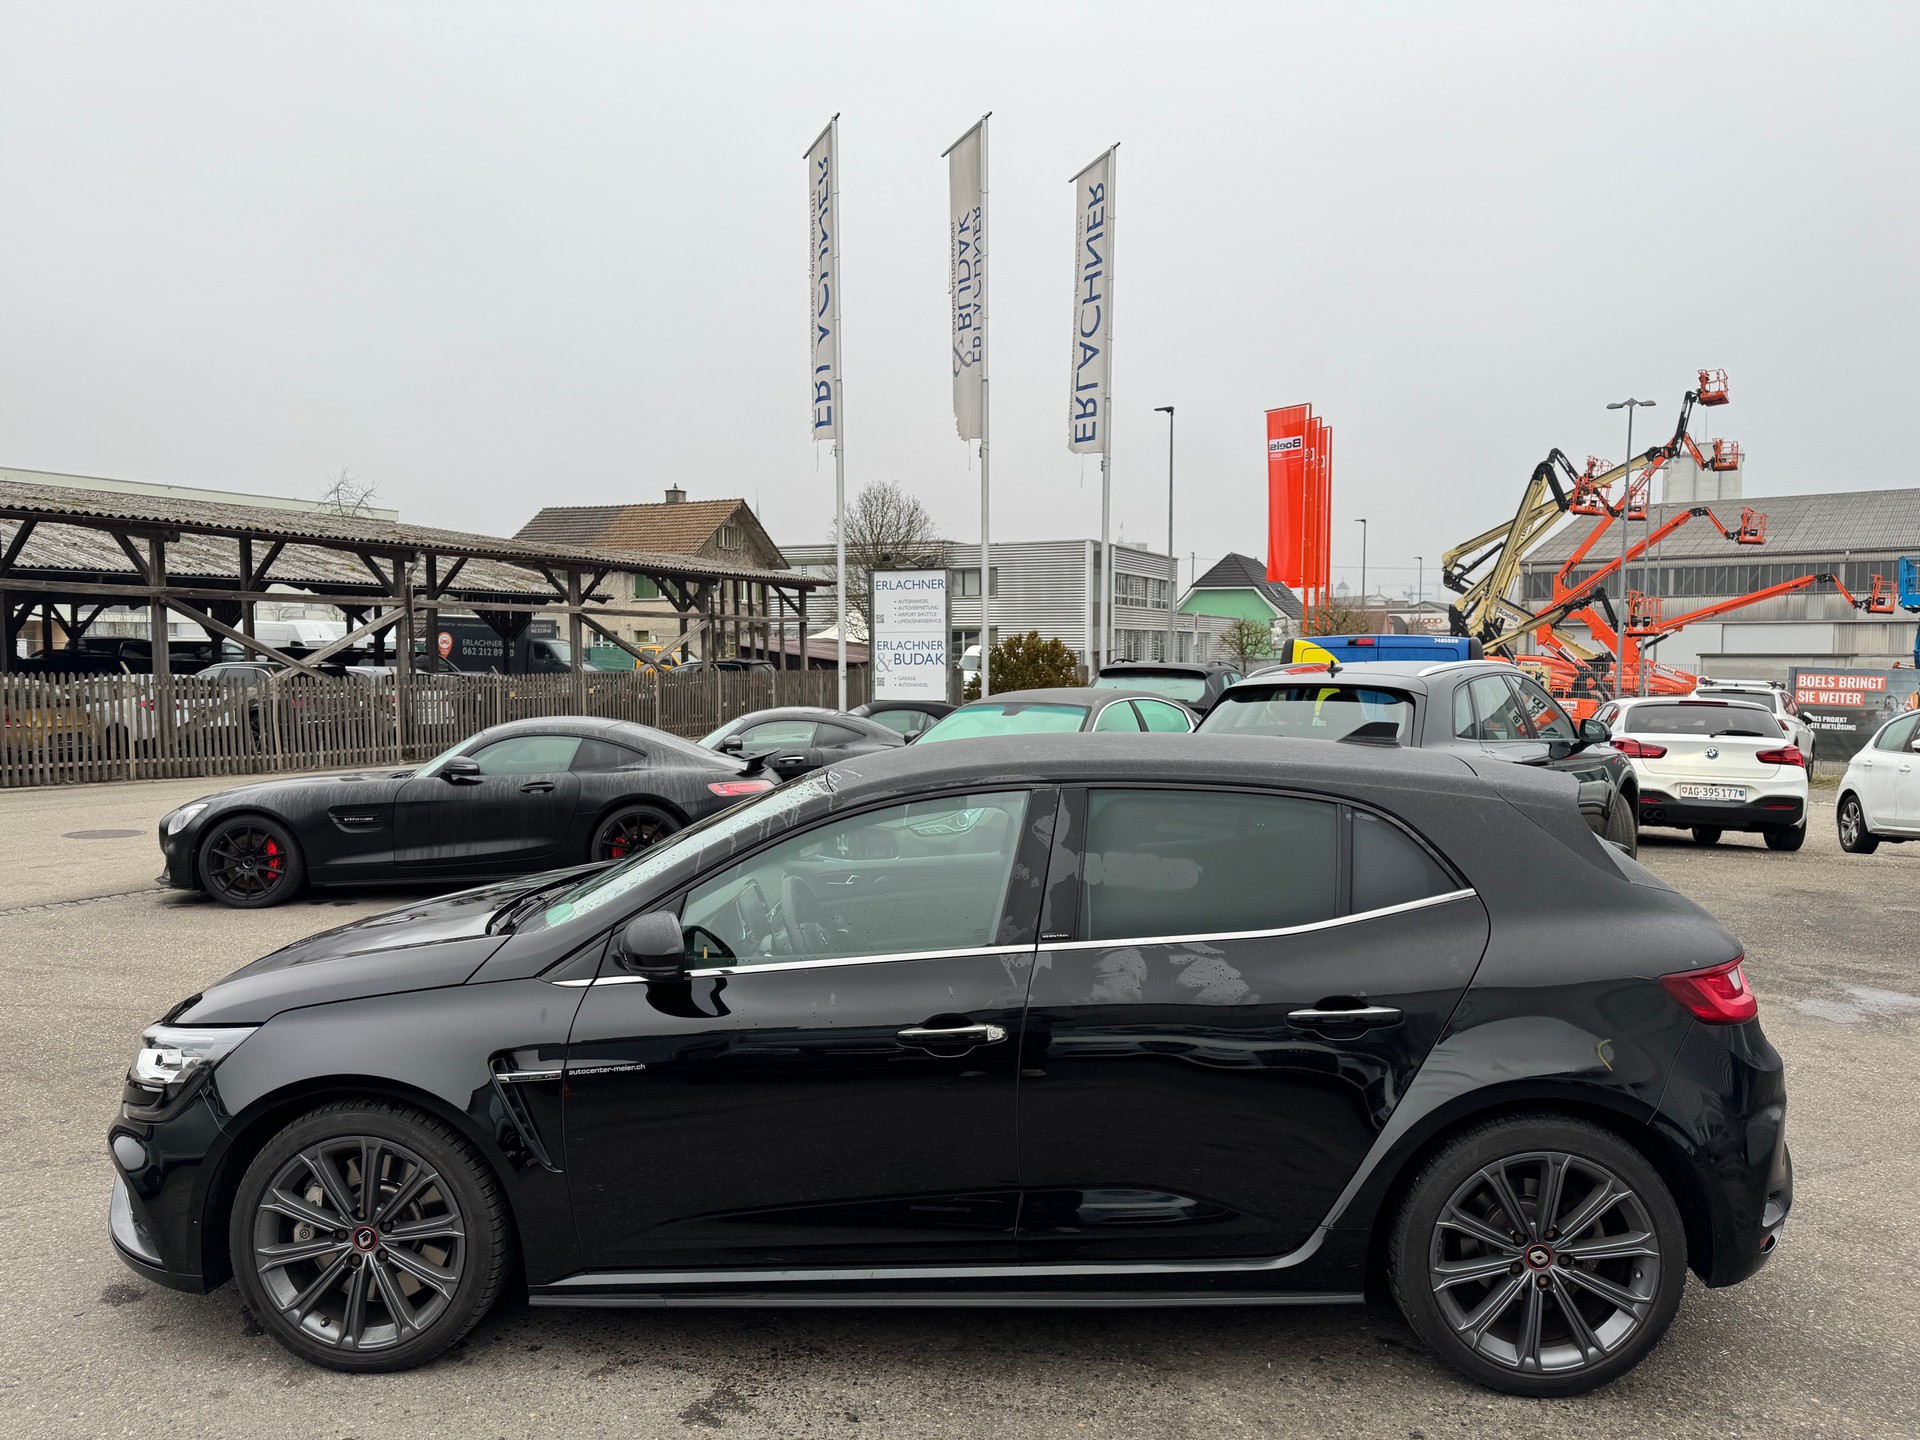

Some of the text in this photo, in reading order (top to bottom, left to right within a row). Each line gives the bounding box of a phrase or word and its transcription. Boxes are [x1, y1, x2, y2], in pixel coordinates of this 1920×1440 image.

[876, 579, 944, 590] ERLACHNER
[462, 638, 514, 648] ERLACHNER.H
[876, 640, 944, 651] ERLACHNER
[462, 647, 477, 655] 062
[478, 648, 492, 656] 212
[876, 653, 944, 672] & BUDAK
[1798, 676, 1884, 690] BOELS BRINGT
[1798, 690, 1862, 704] SIE WEITER
[568, 1063, 646, 1076] autocenter-meier.ch
